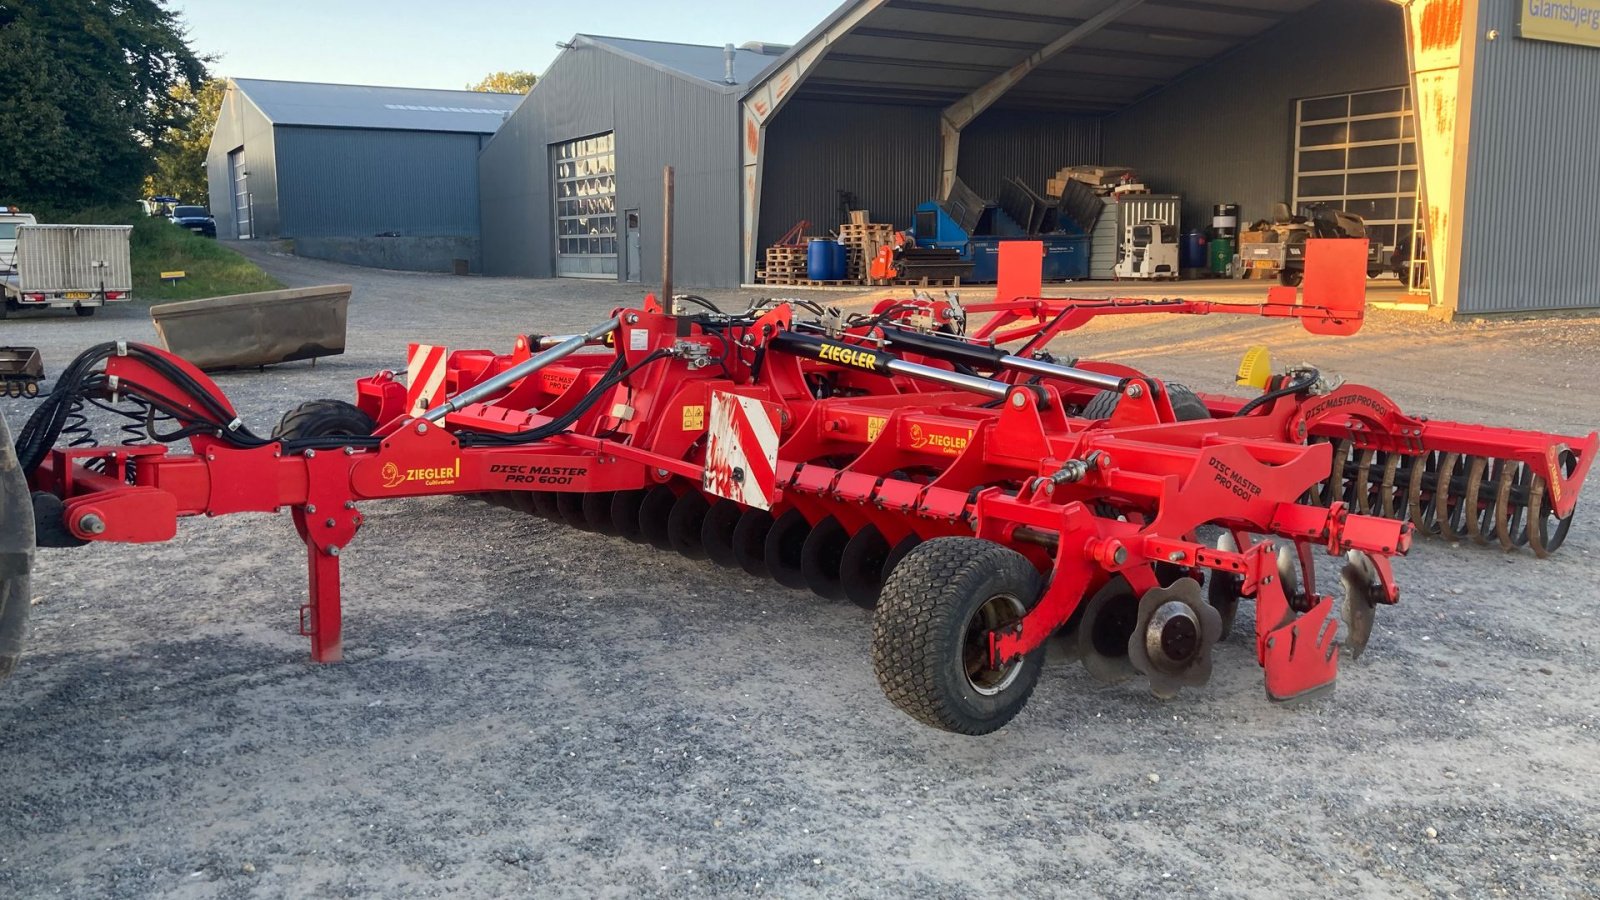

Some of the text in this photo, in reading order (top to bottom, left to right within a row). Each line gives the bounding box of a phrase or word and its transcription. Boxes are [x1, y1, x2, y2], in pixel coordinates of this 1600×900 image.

[1529, 0, 1600, 30] Glamsbjerg
[819, 343, 876, 370] ZIEGLER
[543, 374, 559, 382] DISC
[1305, 394, 1387, 420] DISC MASTER PRO 6001
[928, 434, 967, 449] ZIEGLER
[406, 467, 454, 481] ZIEGLER
[490, 464, 587, 476] DISC MASTER
[505, 475, 574, 485] PRO 6001
[1208, 456, 1262, 497] DISC MASTER
[1214, 473, 1252, 502] PRO 6001
